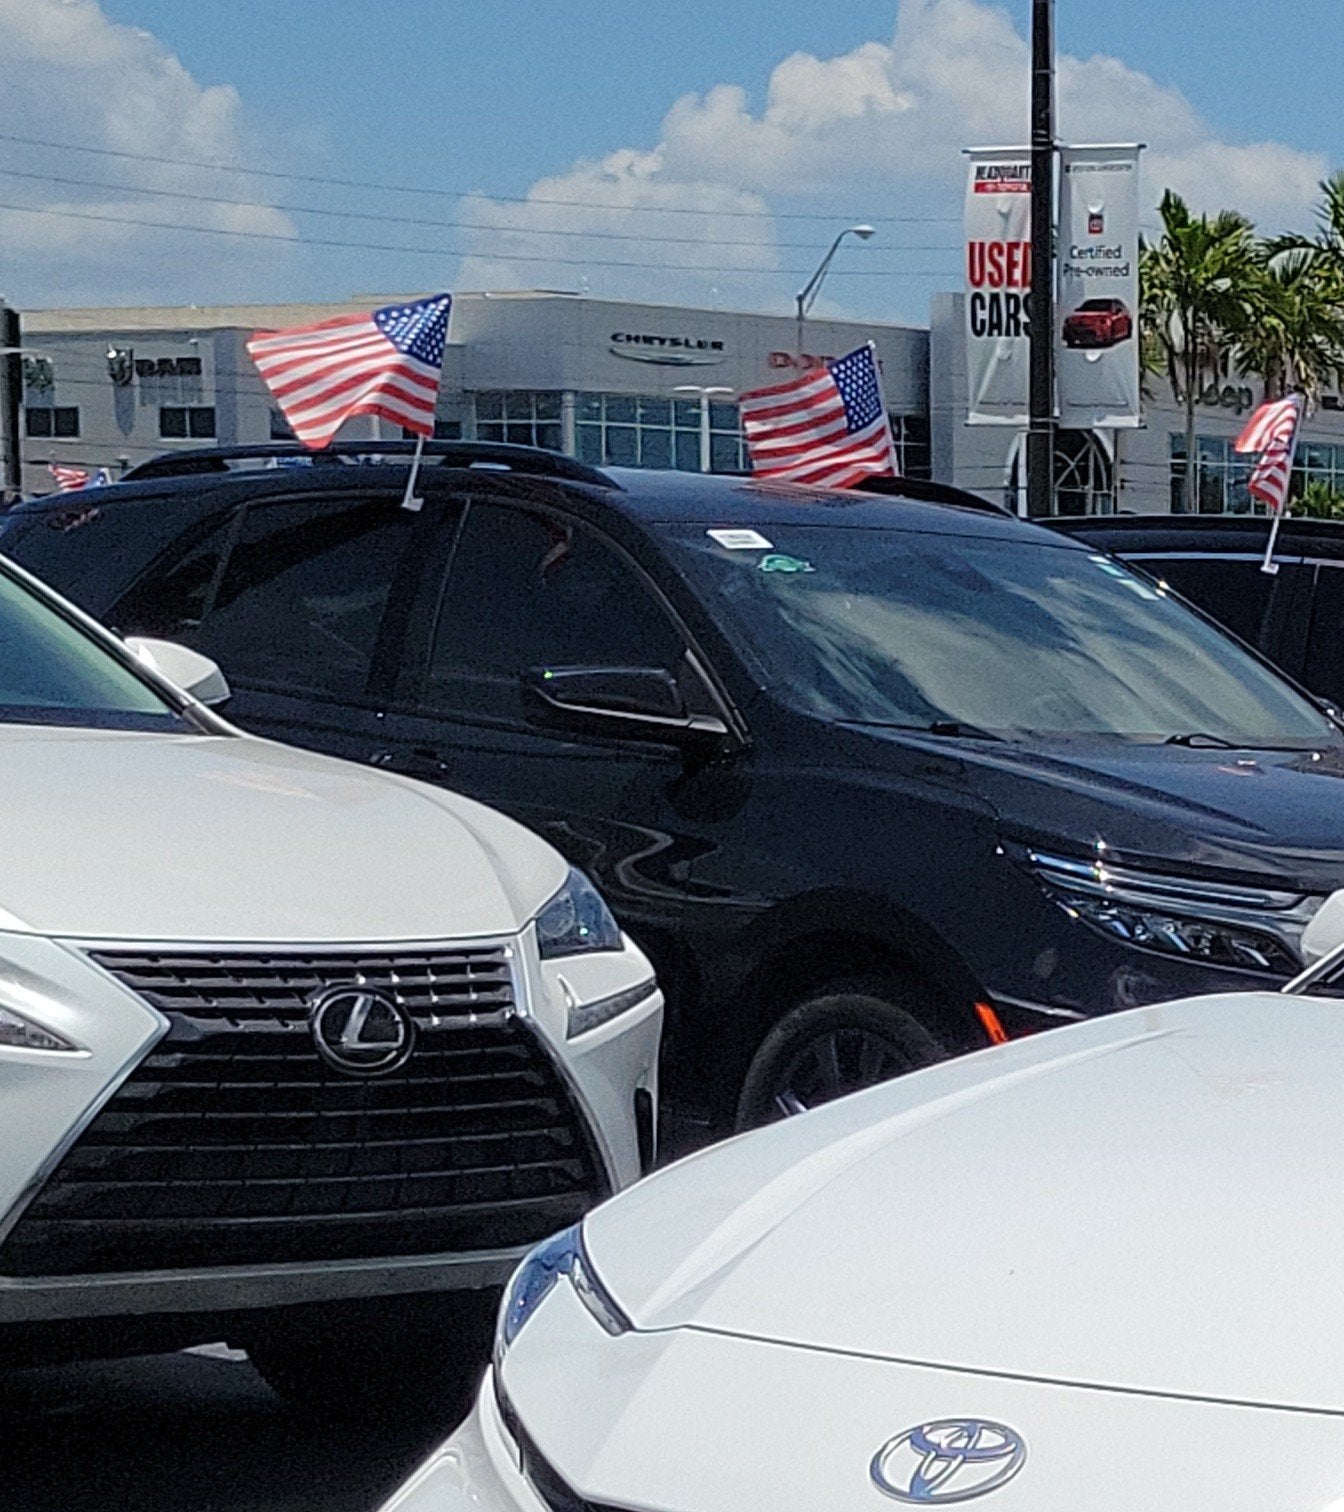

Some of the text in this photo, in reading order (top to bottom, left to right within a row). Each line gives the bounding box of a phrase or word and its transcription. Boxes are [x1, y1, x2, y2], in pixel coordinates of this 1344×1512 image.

[975, 165, 1031, 182] HEADQUART
[1069, 244, 1122, 259] Certified
[1063, 262, 1130, 277] Pre-owned
[610, 332, 724, 351] CHRYSLER
